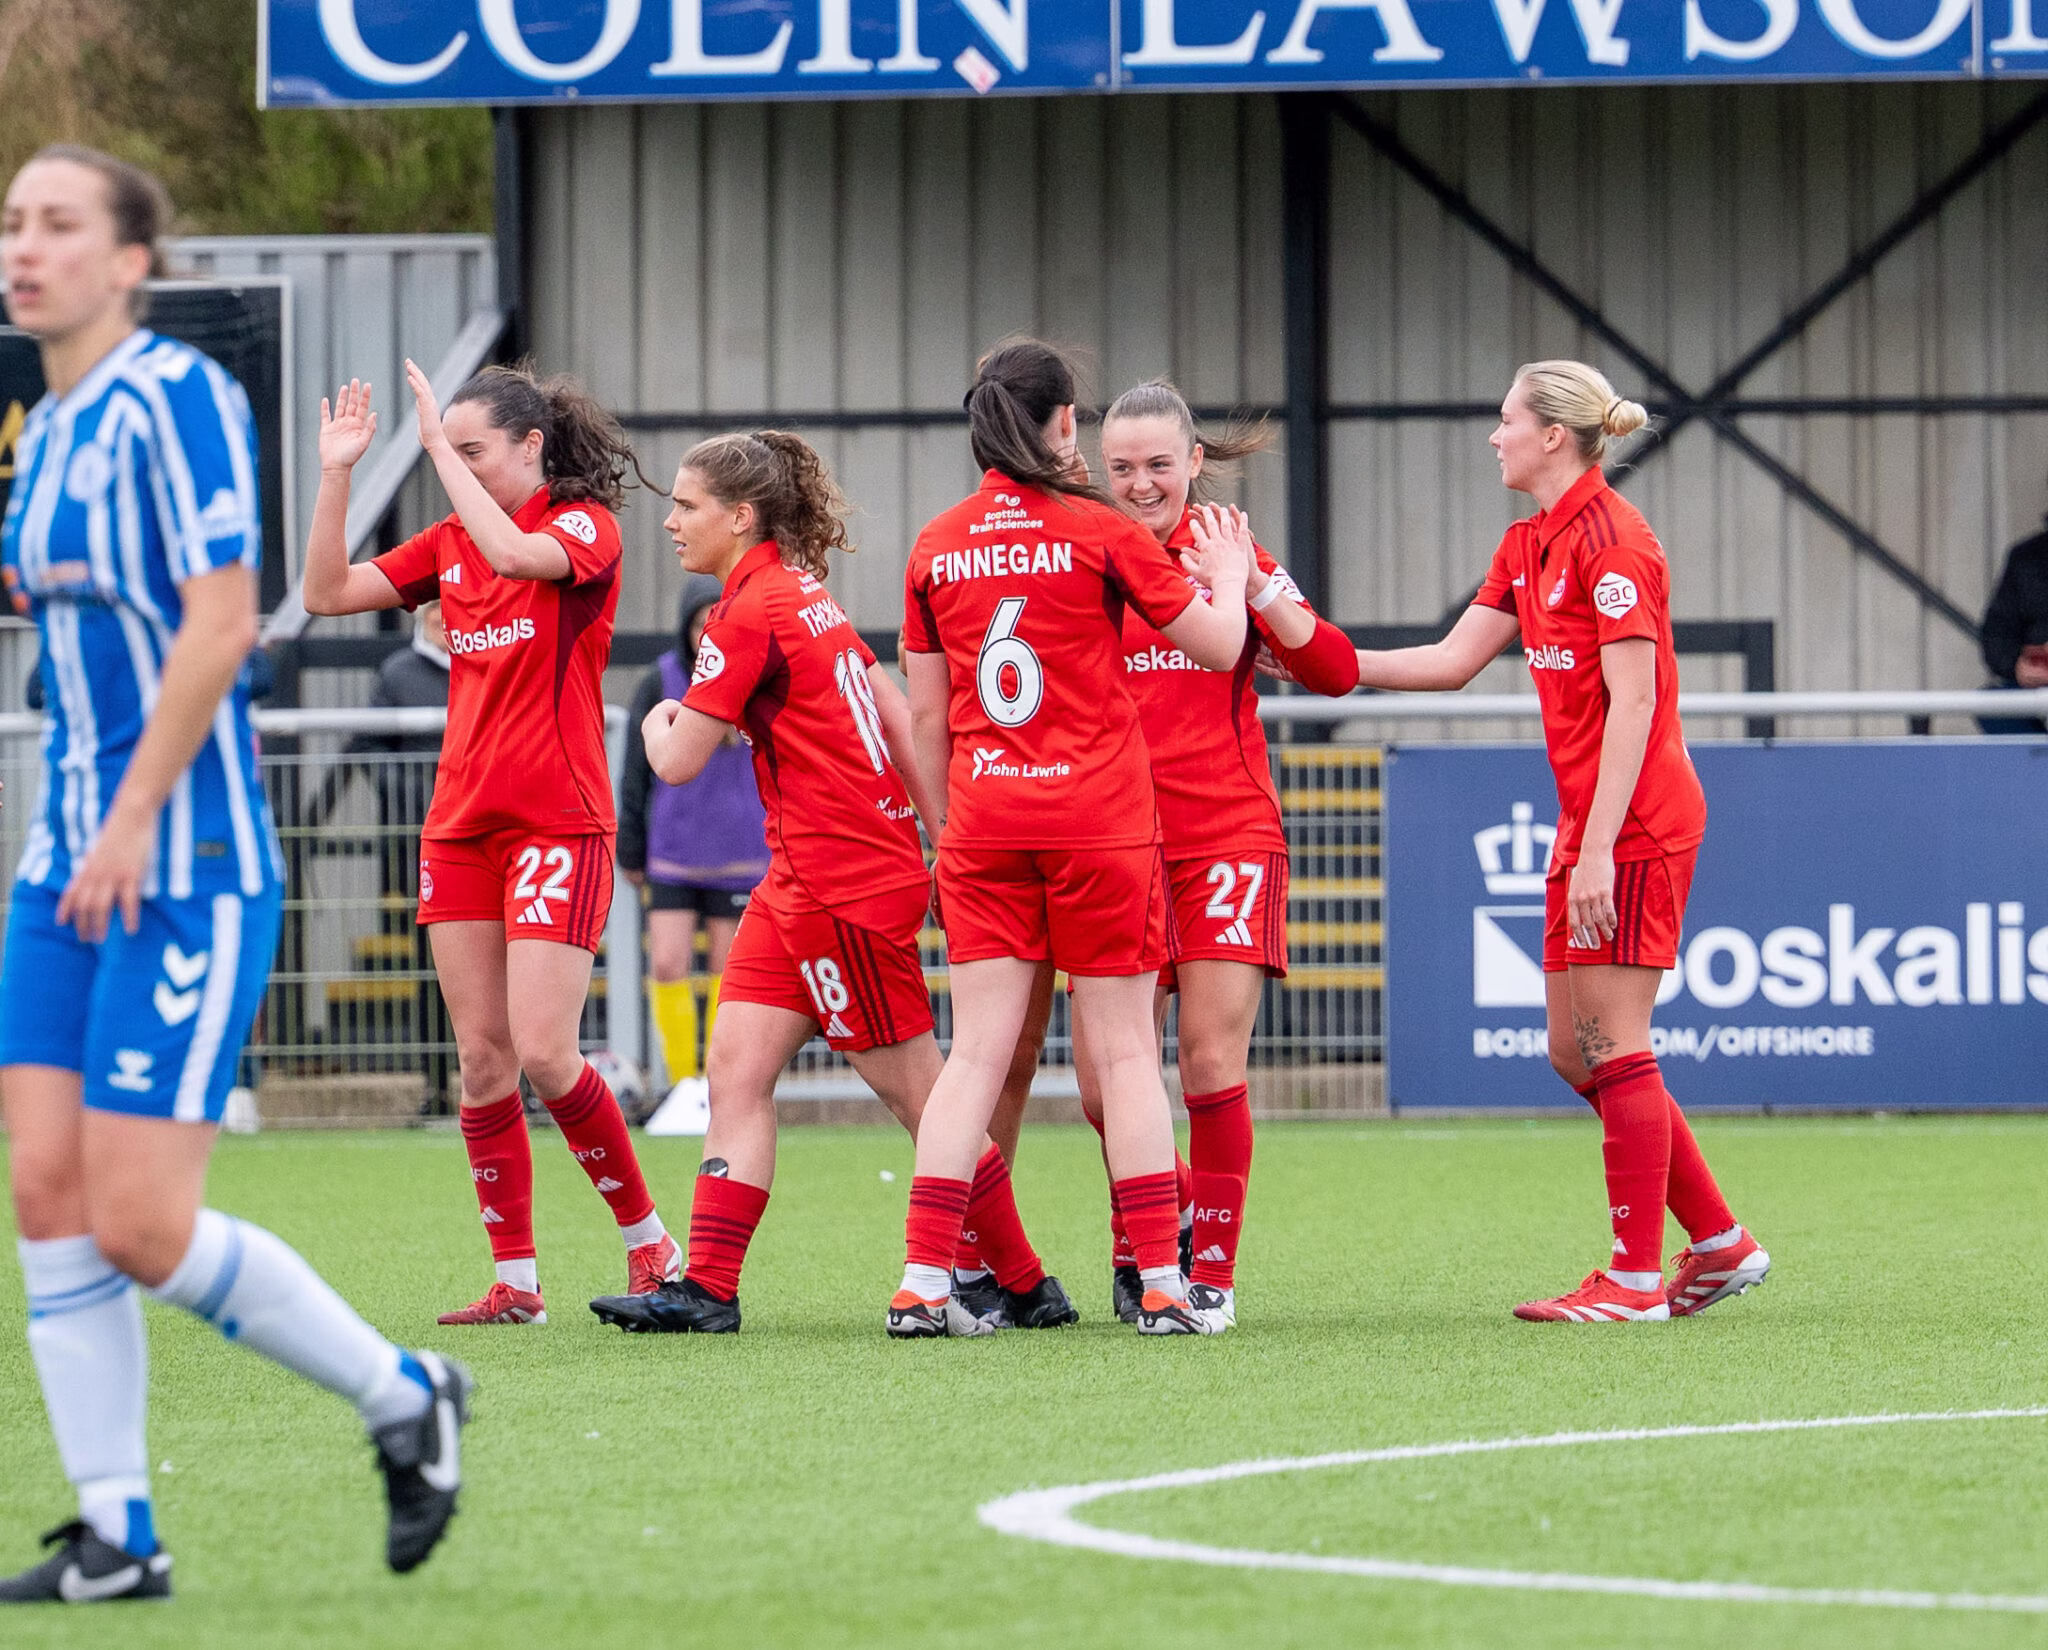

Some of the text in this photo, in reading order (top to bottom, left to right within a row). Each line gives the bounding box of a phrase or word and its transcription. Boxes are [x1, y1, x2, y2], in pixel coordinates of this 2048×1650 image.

[1121, 0, 2048, 66] LAWSO
[969, 518, 1043, 534] Brain Sciences
[984, 508, 1027, 522] Scottish
[931, 542, 1072, 585] FINNEGAN
[977, 597, 1043, 728] 6
[983, 761, 1070, 778] John Lawrie
[514, 845, 573, 902] 22
[1205, 861, 1264, 919] 27
[800, 956, 849, 1013] 18
[1195, 1207, 1232, 1223] AFC
[1608, 1205, 1630, 1219] FC
